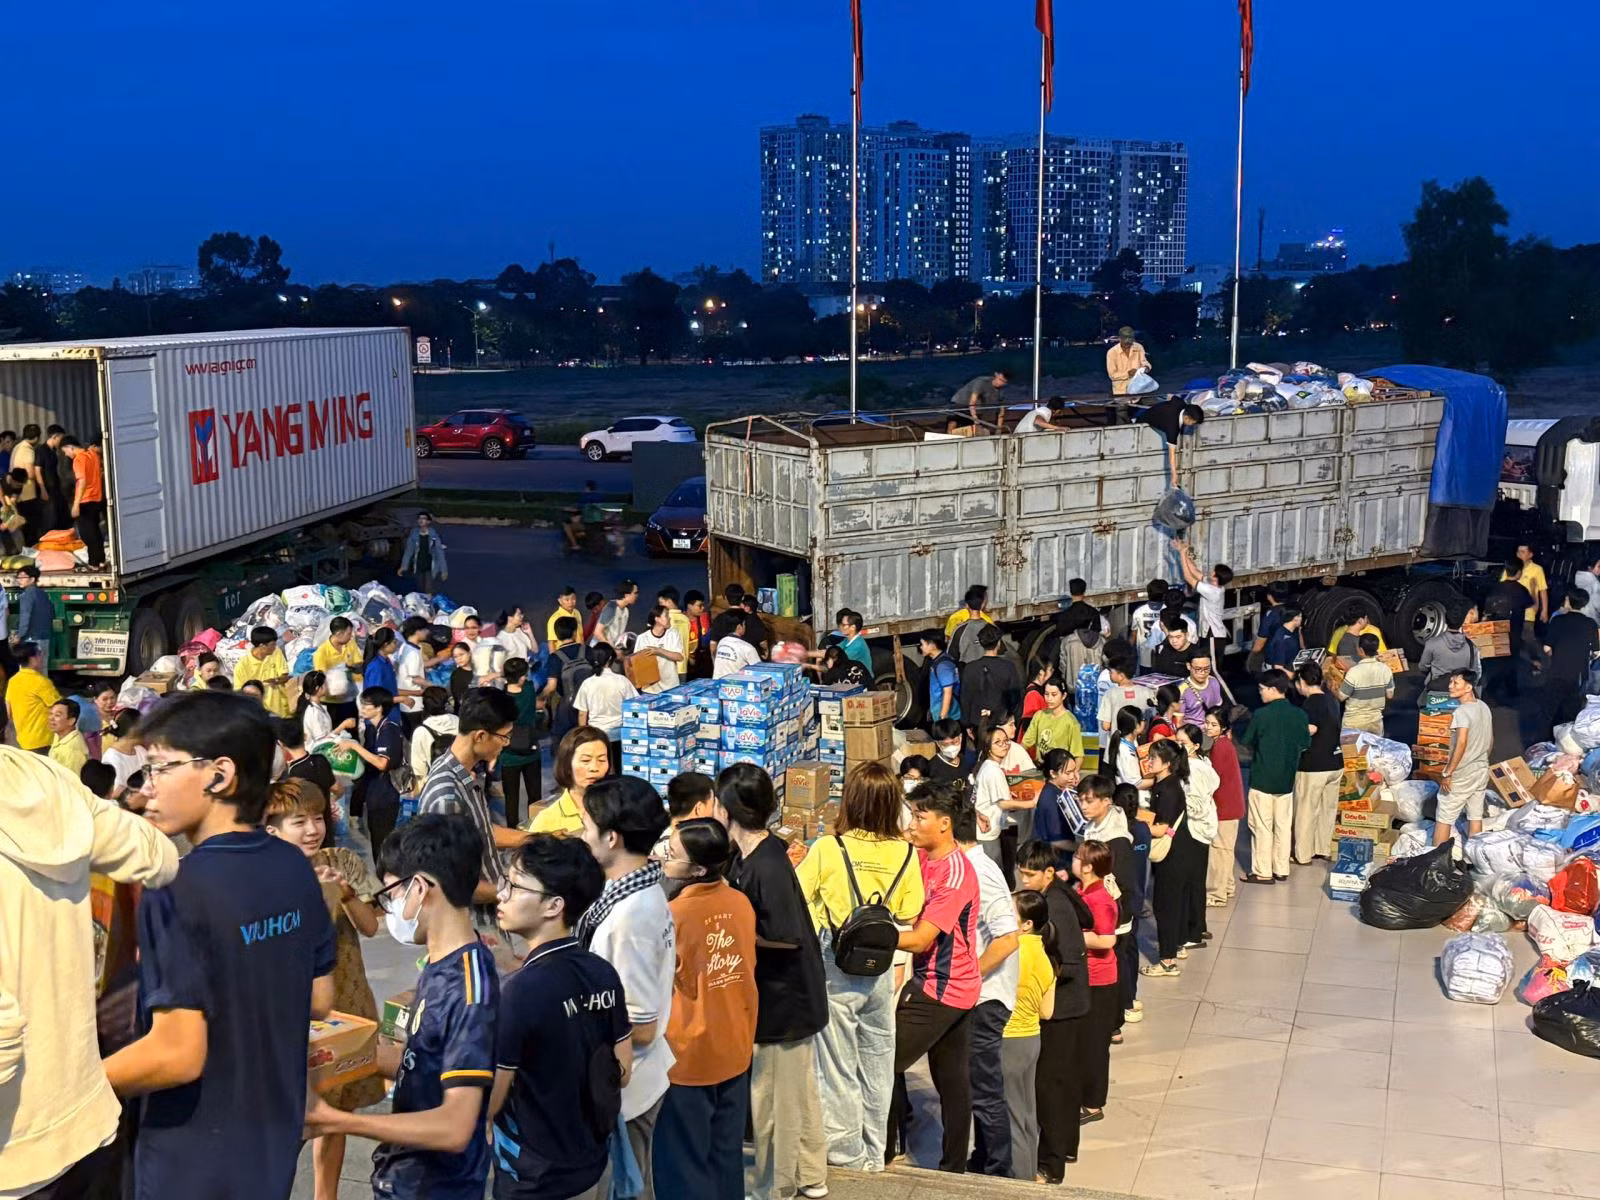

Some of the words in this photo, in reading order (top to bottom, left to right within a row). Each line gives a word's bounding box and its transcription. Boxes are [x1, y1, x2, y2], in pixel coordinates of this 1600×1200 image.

[222, 403, 304, 468] YANG
[308, 391, 373, 451] MING
[706, 929, 734, 953] The
[707, 952, 742, 976] Story
[563, 989, 616, 1018] VN-HCM
